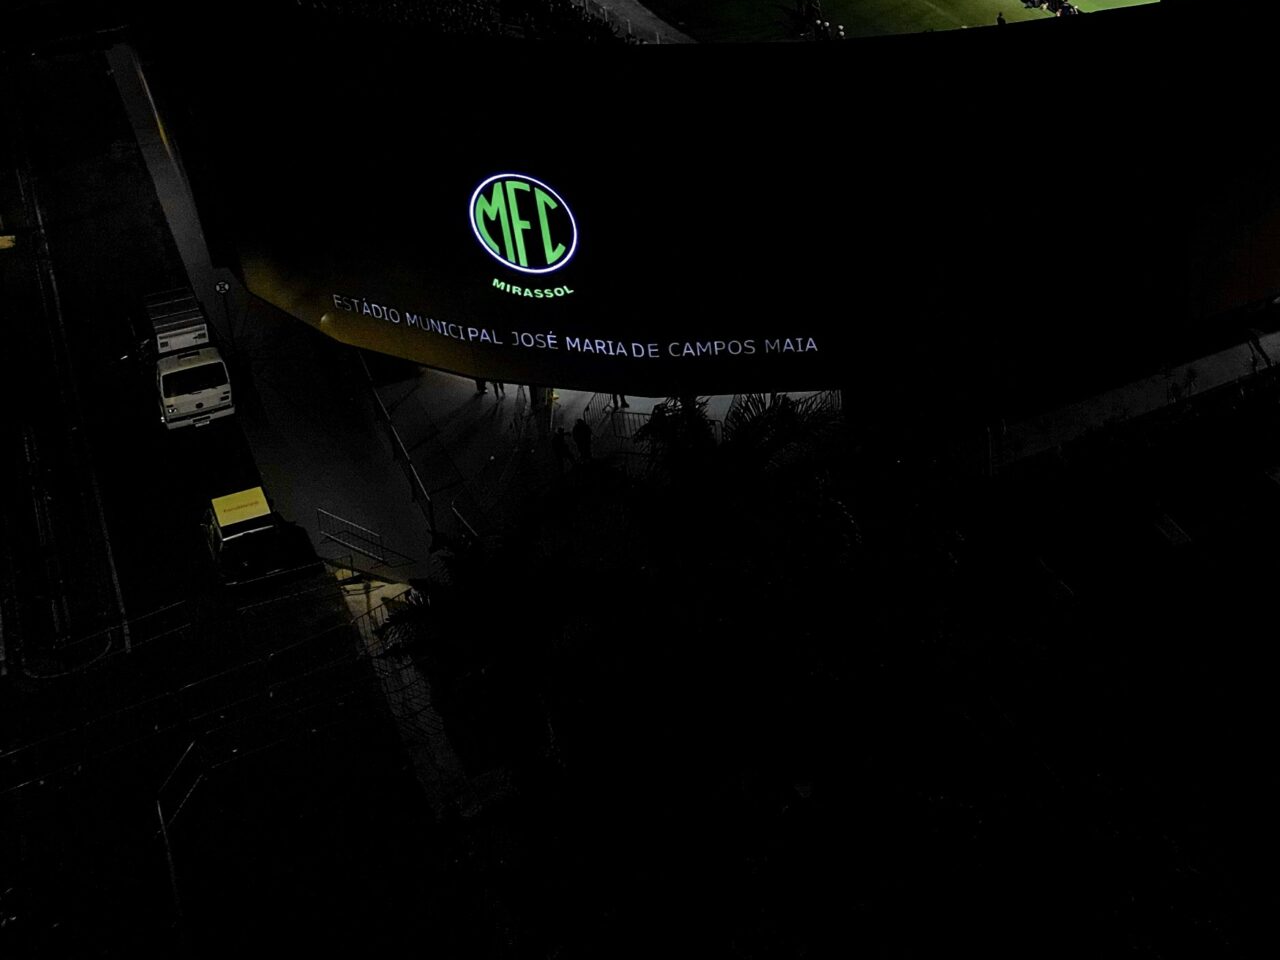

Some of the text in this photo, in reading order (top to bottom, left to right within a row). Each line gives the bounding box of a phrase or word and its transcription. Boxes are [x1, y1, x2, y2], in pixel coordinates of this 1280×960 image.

[475, 181, 567, 268] MFC
[492, 278, 575, 299] MIRASSOL
[333, 294, 819, 359] ESTÁDIO MUNICIPAL JOSÉ MARIA DE CAMPOS MAIA
